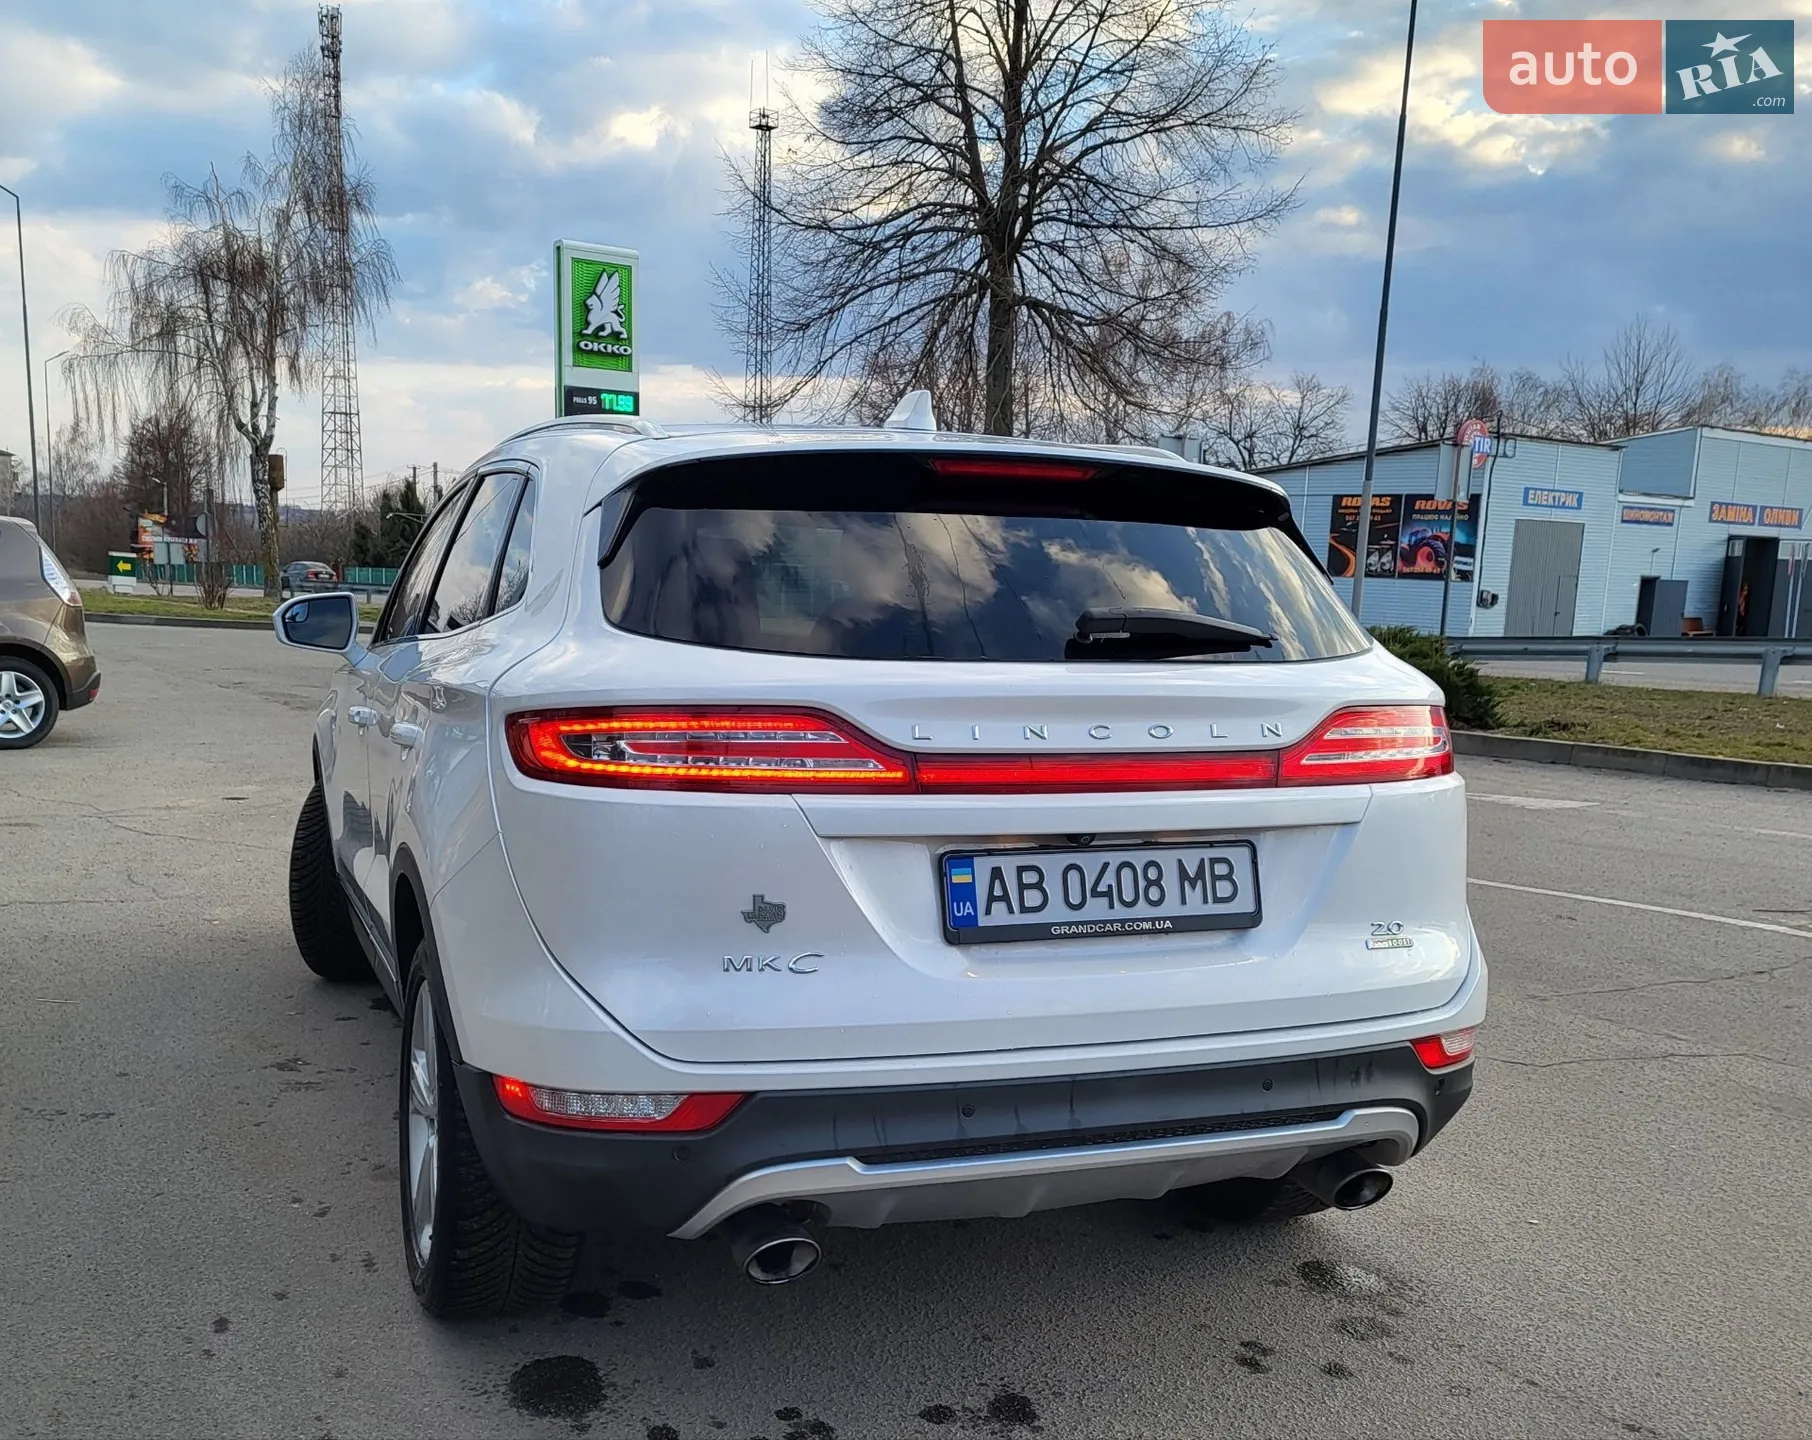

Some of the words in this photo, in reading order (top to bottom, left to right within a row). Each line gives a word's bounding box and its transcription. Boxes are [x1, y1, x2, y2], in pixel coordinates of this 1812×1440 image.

[579, 340, 632, 355] OKKO
[587, 395, 597, 405] 95
[1474, 436, 1491, 453] TIR
[1341, 496, 1392, 506] ROAS
[1527, 489, 1579, 508] ЕЛЕКТРИК
[1711, 503, 1754, 523] ЗАМІНА
[1762, 507, 1800, 526] ОЛИВИ
[911, 721, 1284, 742] LINCOLN
[953, 901, 975, 917] UA
[984, 864, 1050, 917] AB
[1061, 859, 1167, 911] 0408
[1177, 856, 1240, 906] MB
[1050, 919, 1173, 935] GRANDCAR.COM.UA
[722, 951, 826, 974] MKC
